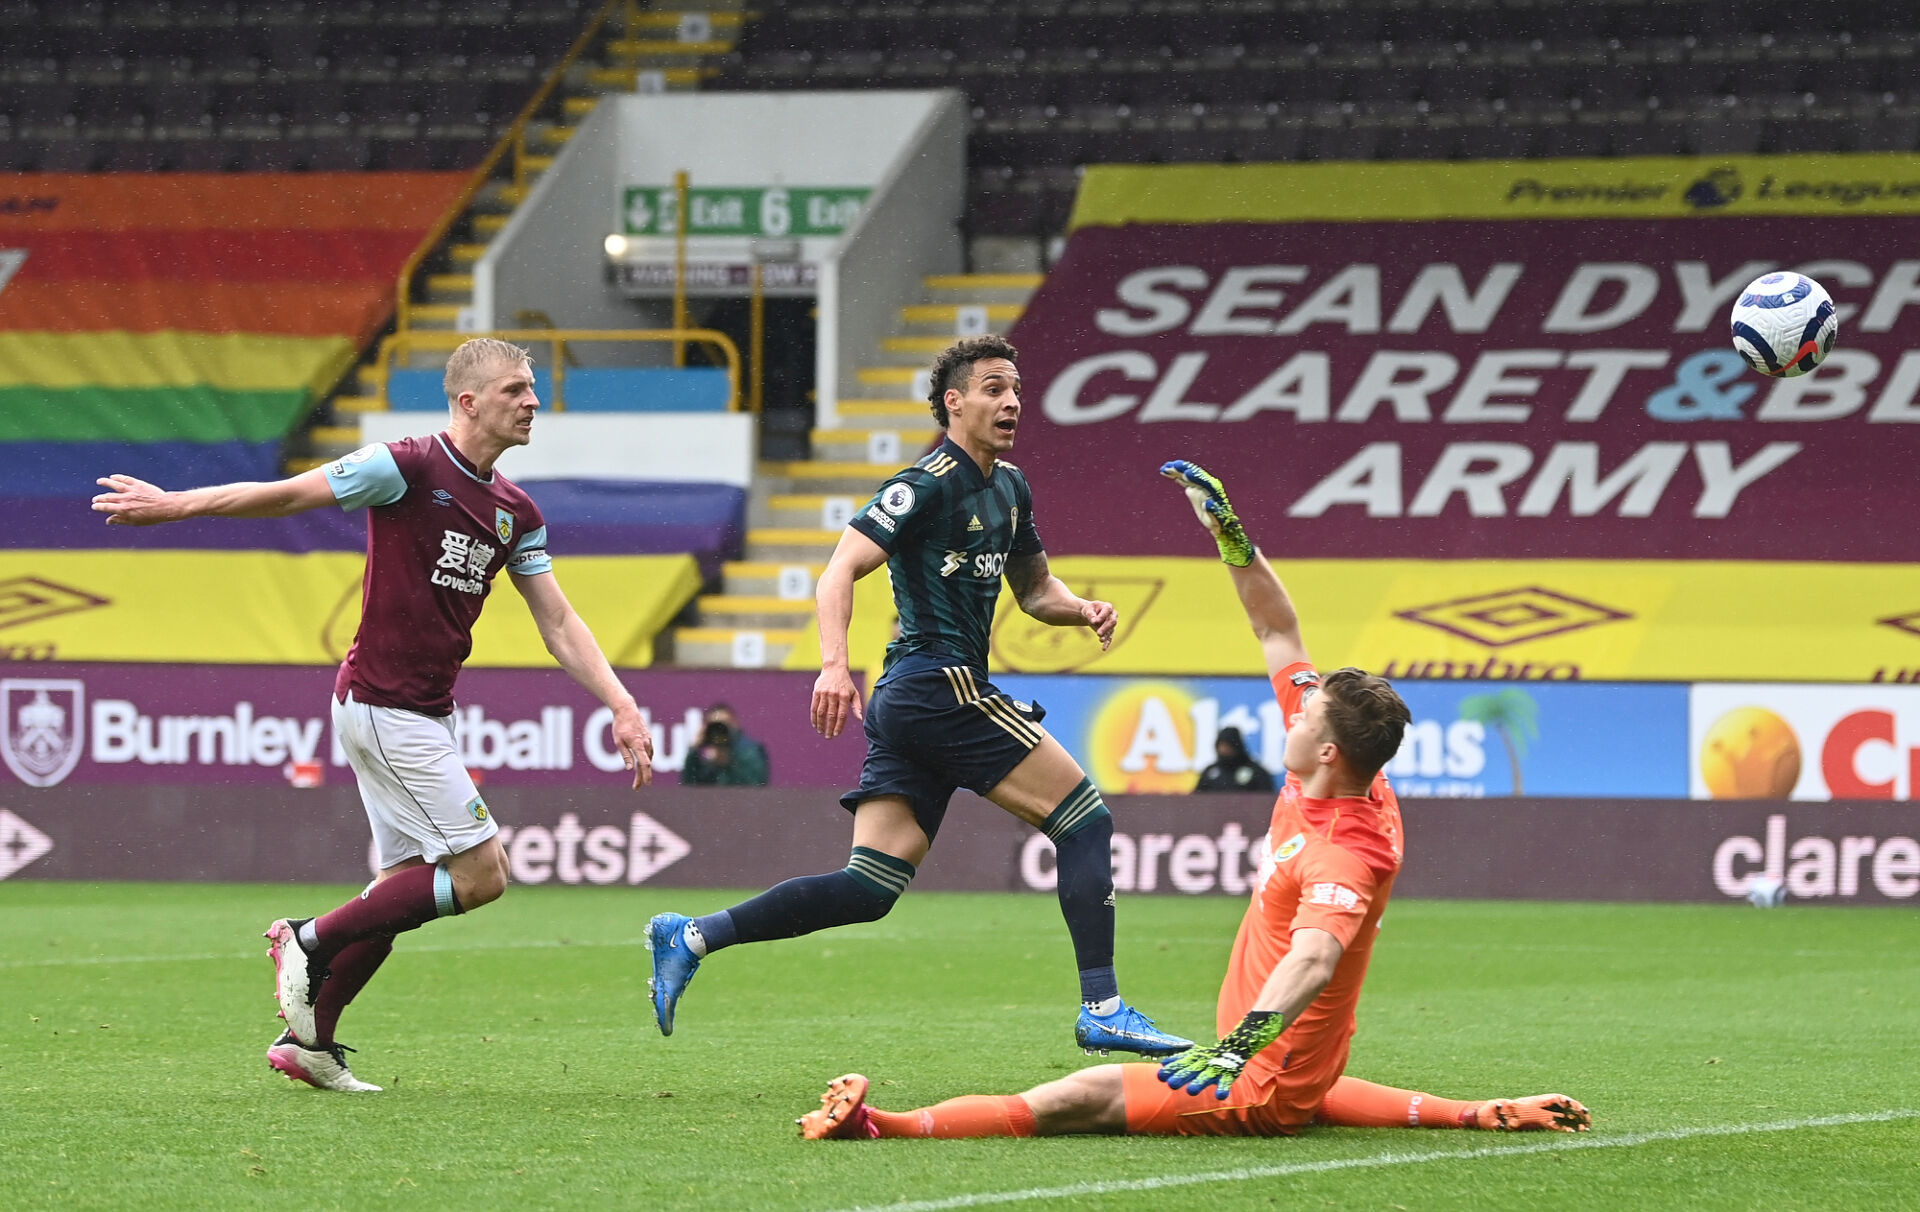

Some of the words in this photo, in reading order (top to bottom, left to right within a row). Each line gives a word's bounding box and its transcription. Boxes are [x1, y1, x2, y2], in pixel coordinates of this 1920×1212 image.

[759, 188, 791, 236] 6
[1094, 262, 1526, 337] SEAN
[1287, 441, 1804, 518] ARMY
[92, 699, 323, 766] Burnley
